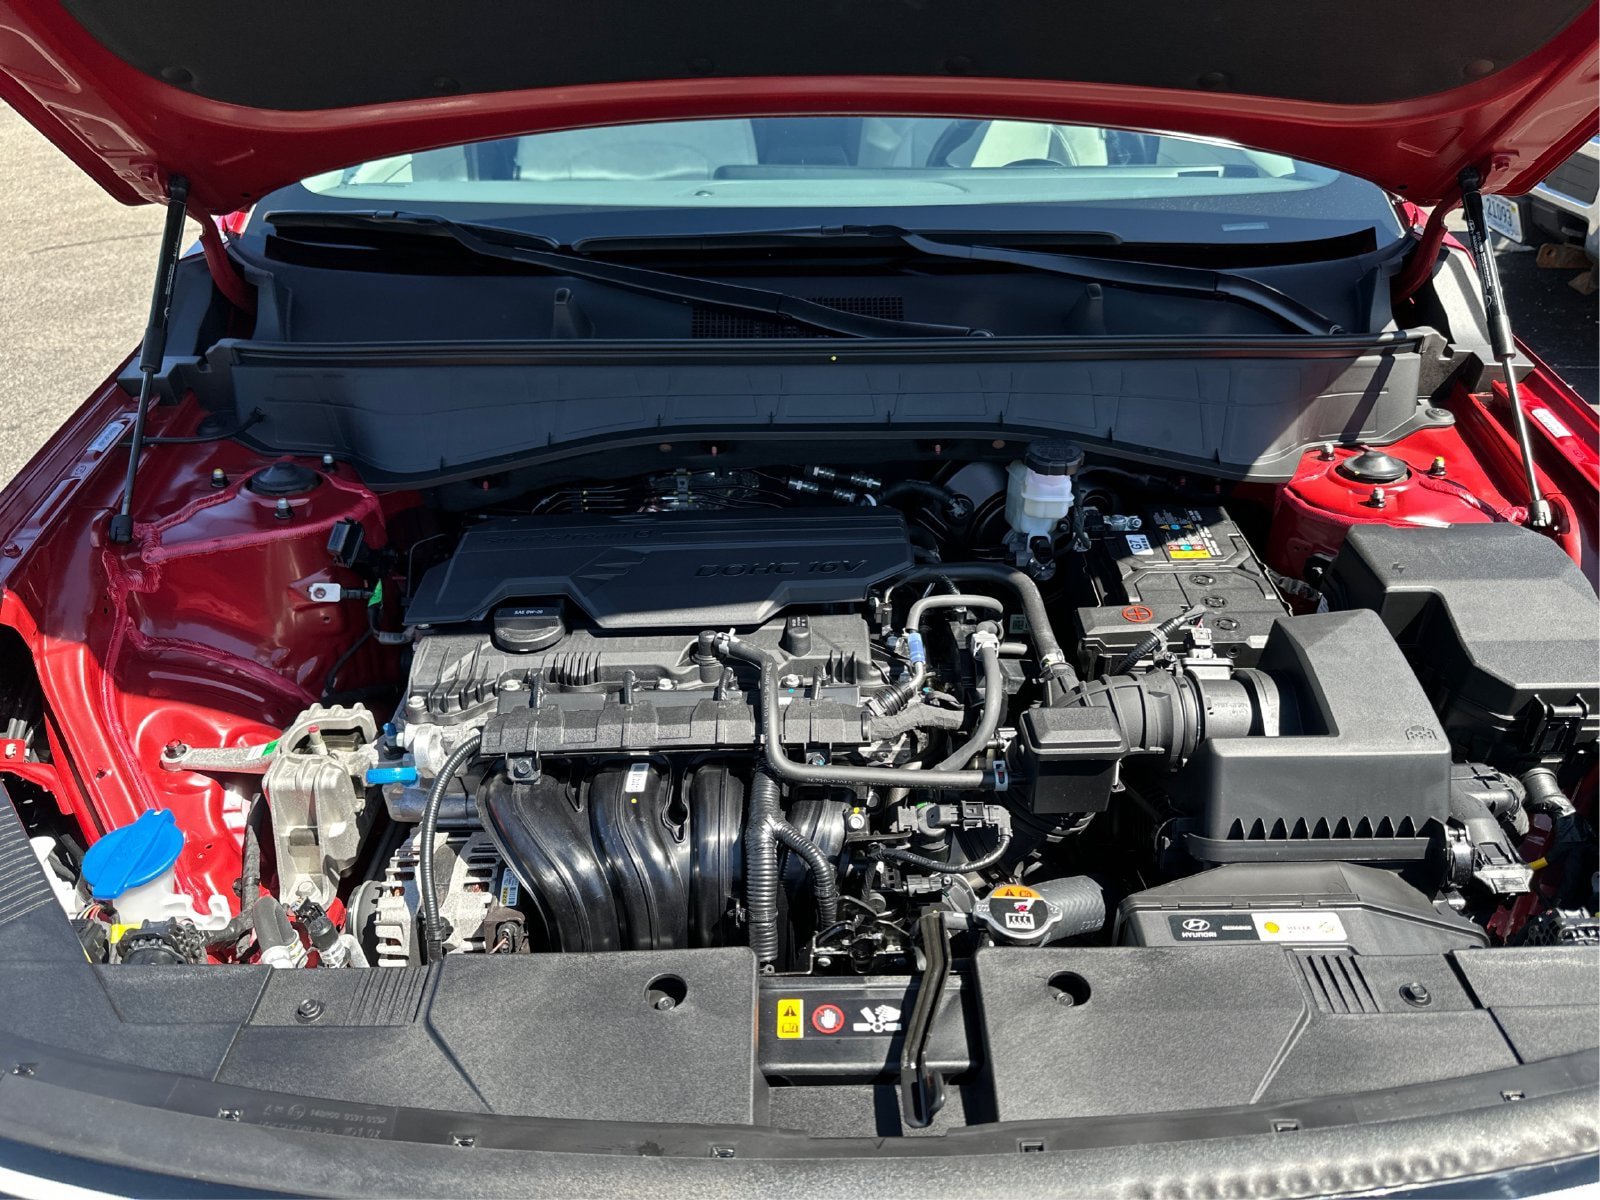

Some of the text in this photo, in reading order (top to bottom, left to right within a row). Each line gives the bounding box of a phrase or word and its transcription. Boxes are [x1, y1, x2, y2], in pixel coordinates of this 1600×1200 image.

[1130, 538, 1142, 550] G7
[694, 559, 868, 577] DOHC 16V
